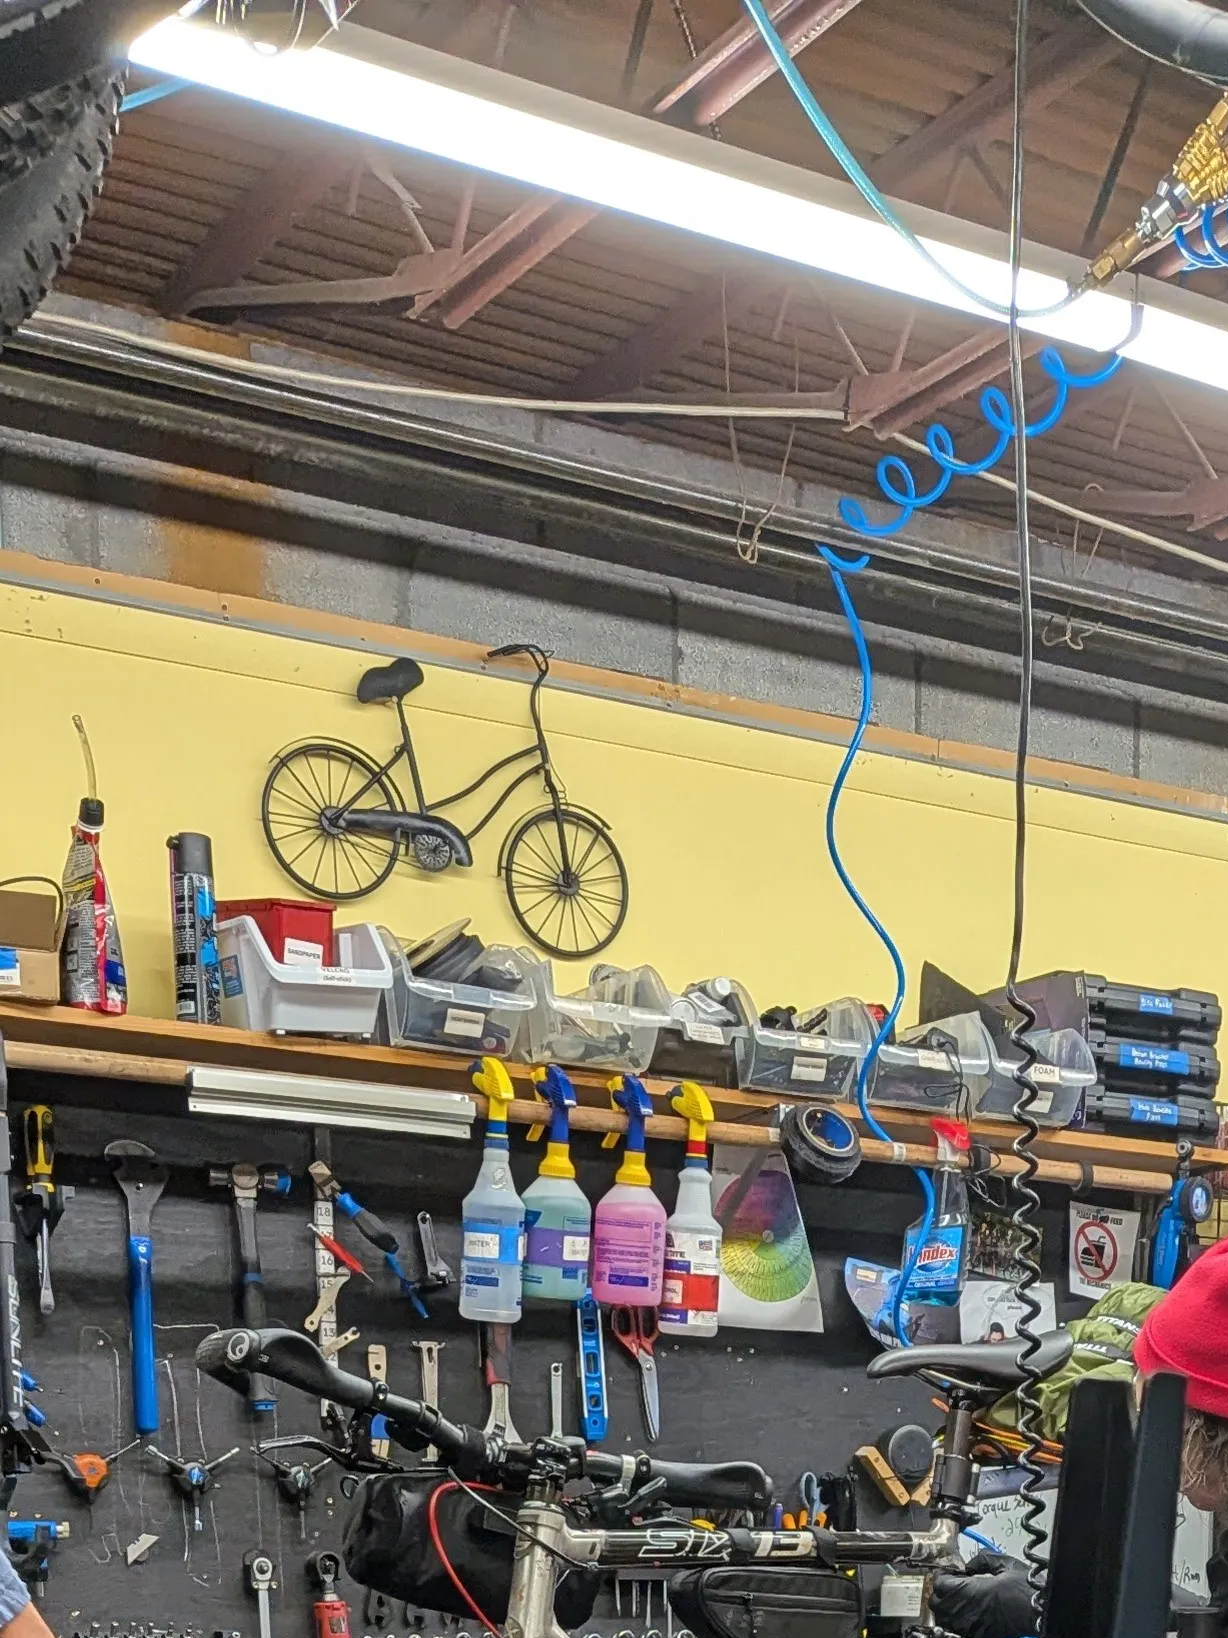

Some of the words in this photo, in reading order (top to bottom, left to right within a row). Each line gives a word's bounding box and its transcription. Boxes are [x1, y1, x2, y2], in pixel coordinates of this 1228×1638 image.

[287, 947, 321, 959] SANDPAPER
[1034, 1066, 1055, 1076] FOAM
[318, 1206, 330, 1217] 18
[1110, 1217, 1123, 1226] FEED
[908, 1244, 956, 1263] index
[322, 1255, 333, 1265] 16
[321, 1279, 333, 1289] 15
[324, 1327, 336, 1338] 13
